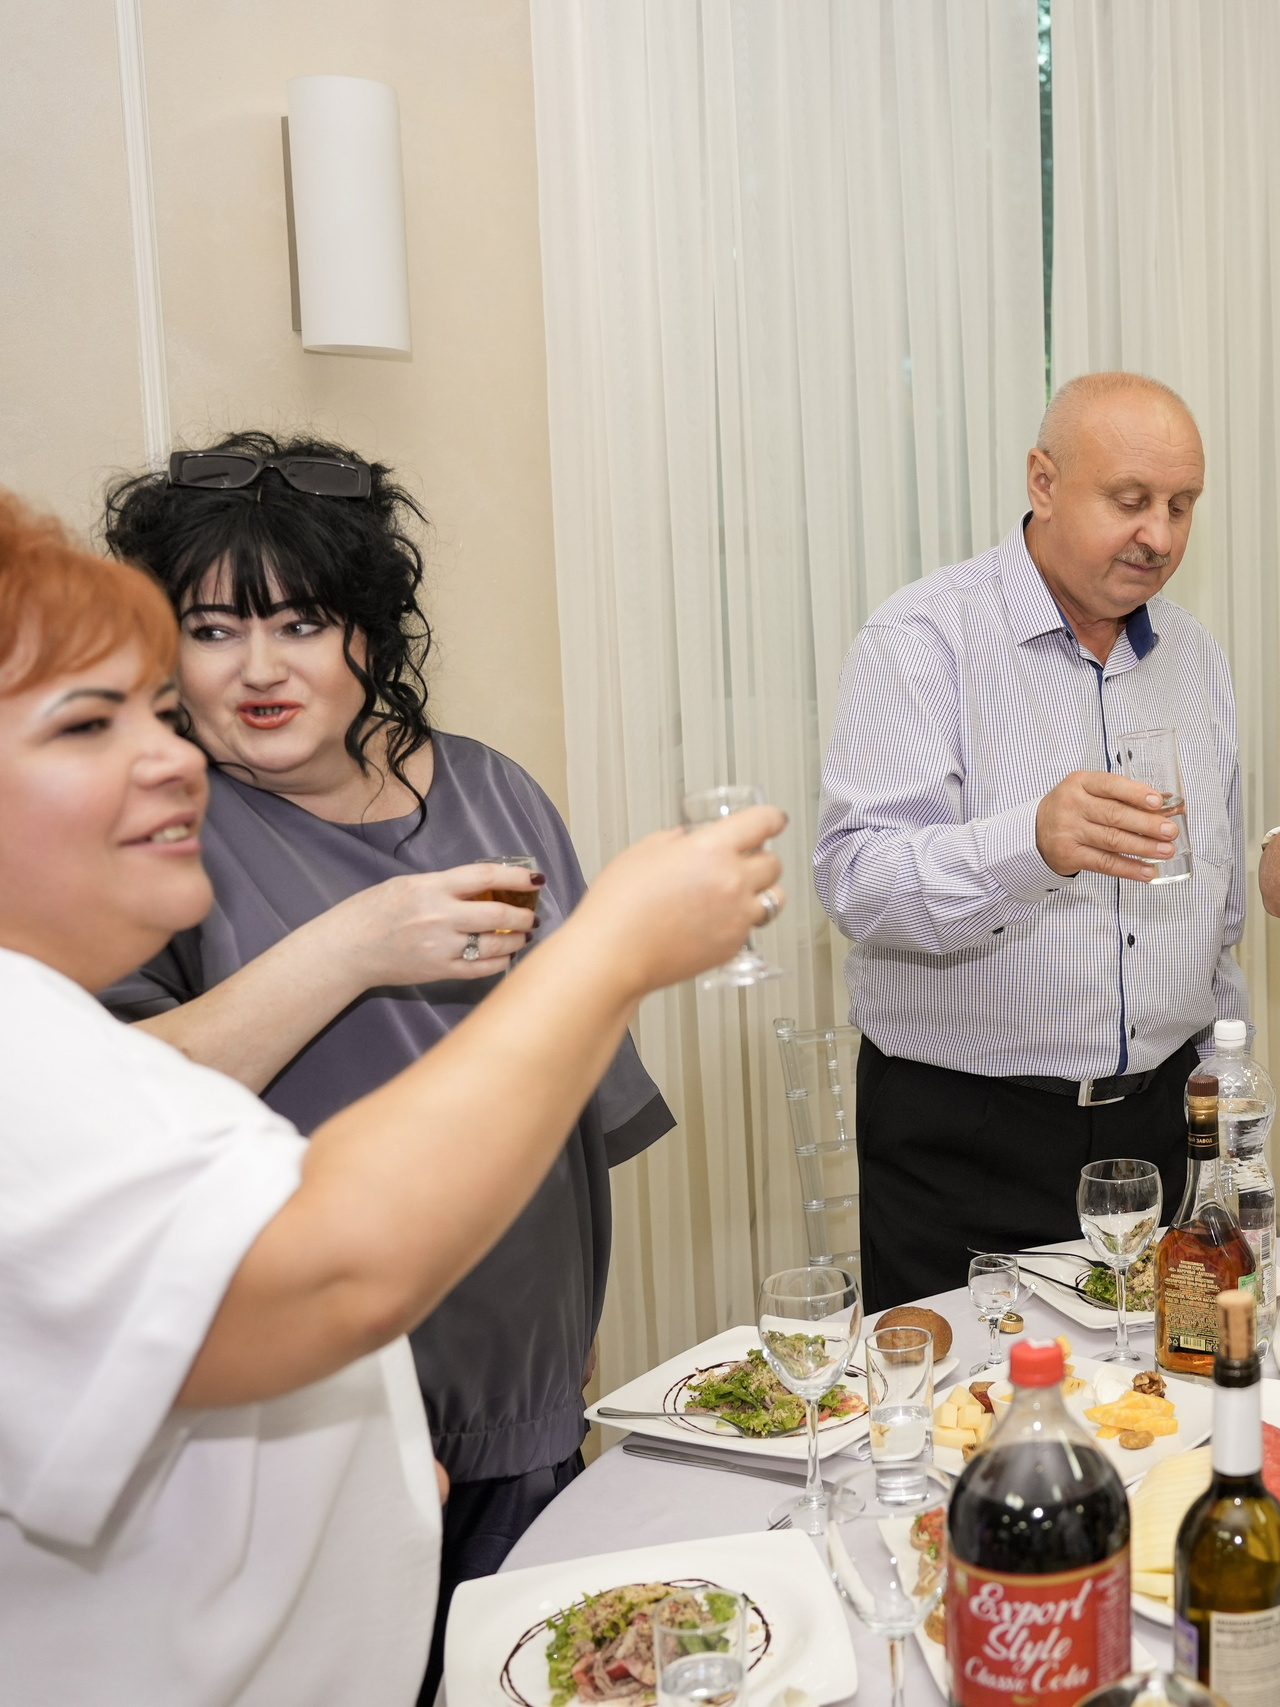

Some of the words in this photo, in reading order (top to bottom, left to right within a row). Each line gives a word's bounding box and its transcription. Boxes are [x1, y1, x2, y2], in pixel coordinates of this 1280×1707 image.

[969, 1578, 1093, 1642] Export
[964, 1656, 1029, 1693] Classic
[1030, 1660, 1090, 1694] Cola
[982, 1622, 1073, 1675] Style
